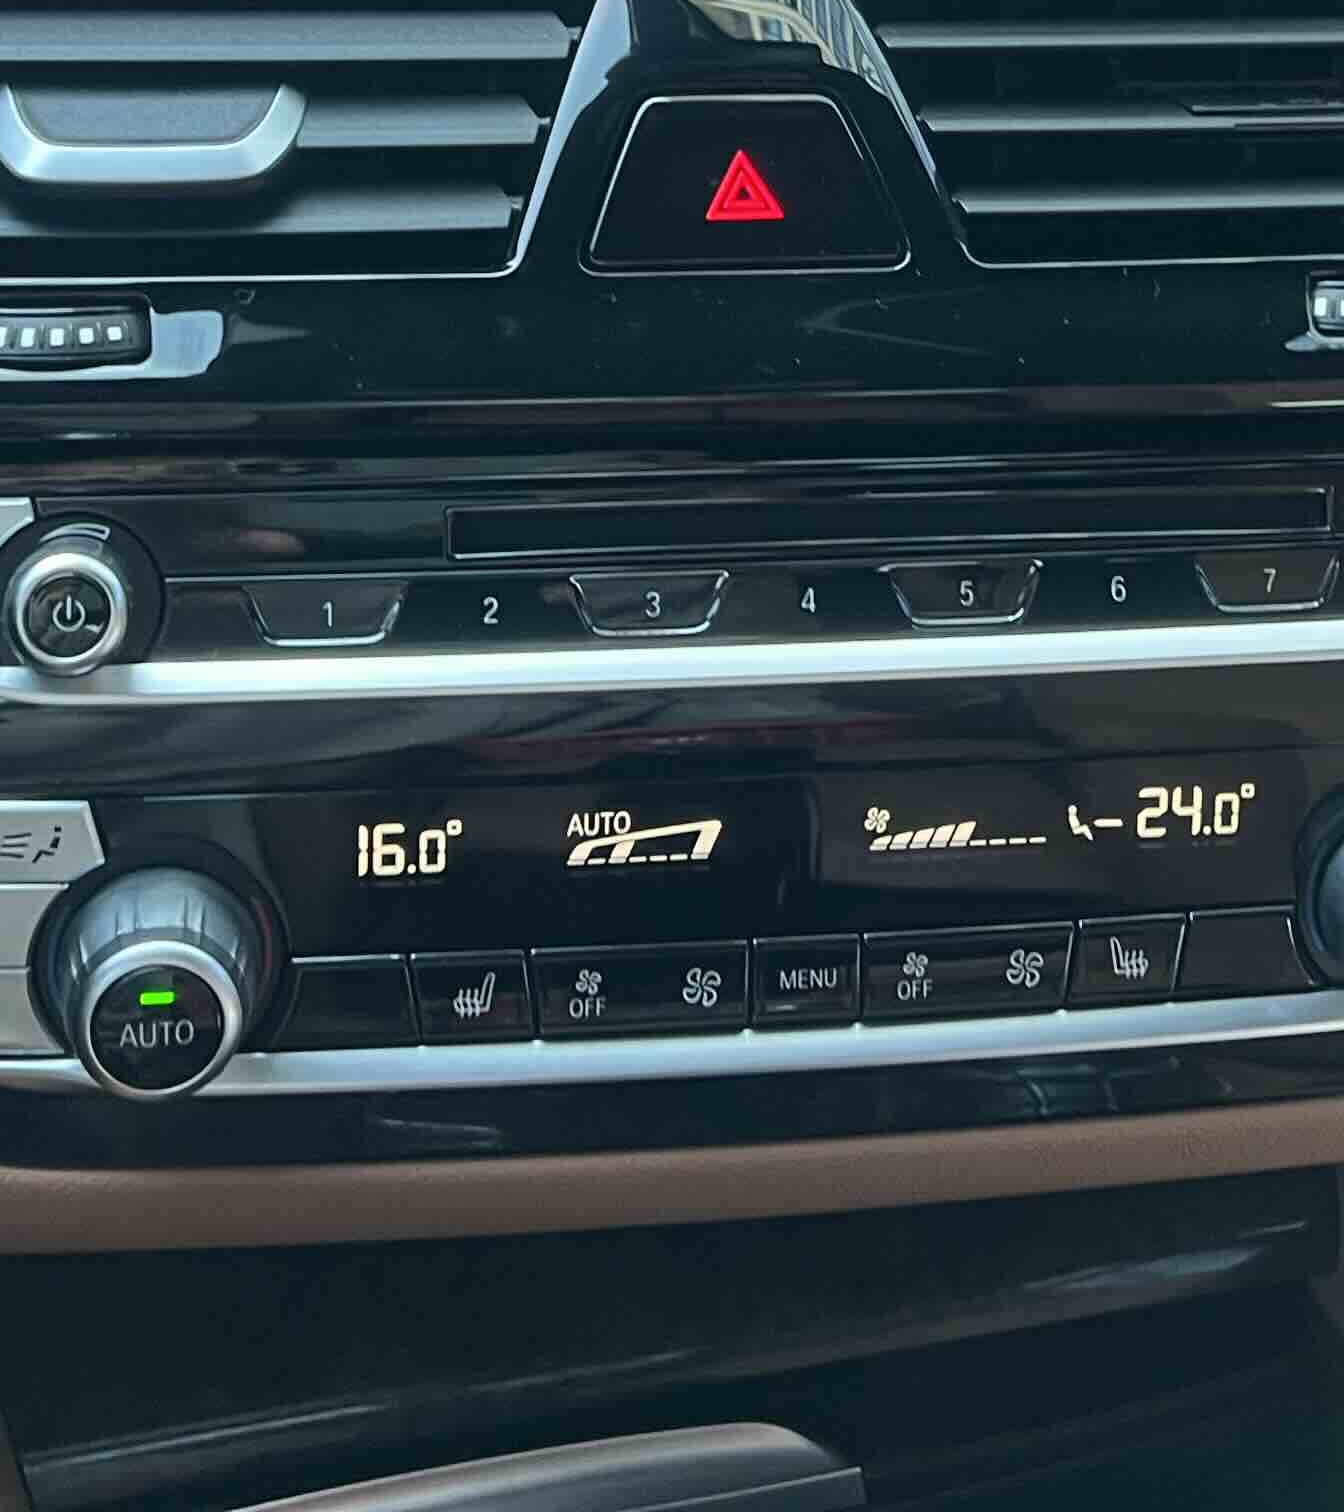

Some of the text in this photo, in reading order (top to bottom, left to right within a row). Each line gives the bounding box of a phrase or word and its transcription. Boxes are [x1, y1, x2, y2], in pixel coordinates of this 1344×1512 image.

[959, 579, 975, 607] 5
[1110, 575, 1127, 603] 6
[1263, 568, 1278, 593] 7
[482, 596, 500, 625] 2
[645, 590, 662, 618] 3
[800, 586, 817, 614] 4
[323, 601, 334, 628] 1
[567, 810, 632, 837] AUTO
[778, 967, 838, 991] MENU
[896, 978, 933, 1001] OFF
[568, 996, 607, 1019] OFF
[118, 1019, 195, 1049] AUTO
